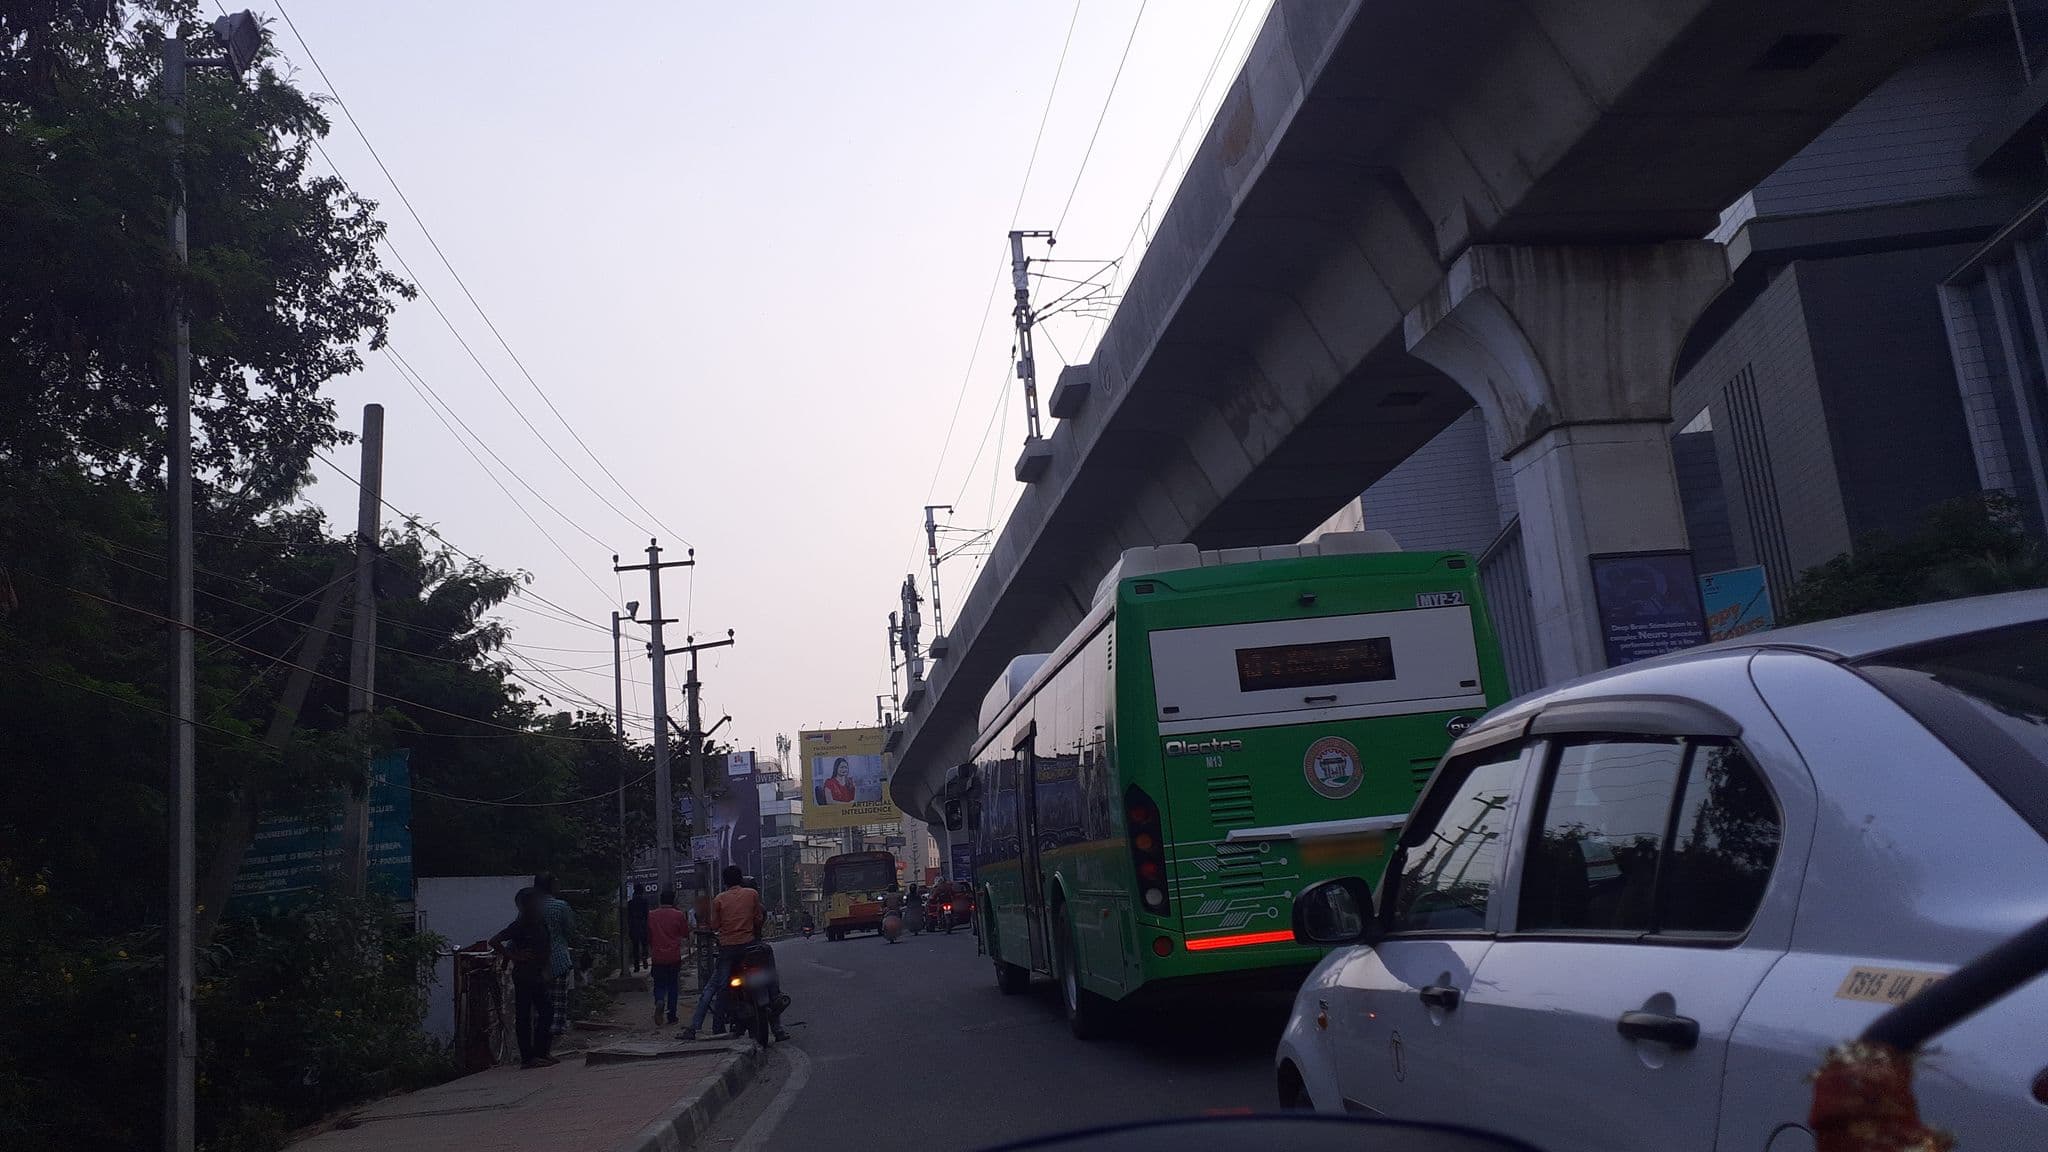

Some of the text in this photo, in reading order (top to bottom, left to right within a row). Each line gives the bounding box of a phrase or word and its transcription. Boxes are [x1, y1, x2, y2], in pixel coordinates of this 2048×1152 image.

[1420, 592, 1462, 606] MYP-2
[1638, 631, 1669, 640] Neuro
[1165, 737, 1243, 757] Olectra
[755, 774, 781, 784] OWERS
[853, 800, 892, 808] ARTIFICIAL
[841, 805, 893, 816] INTELLIGENCE
[1847, 971, 1889, 996] TS15
